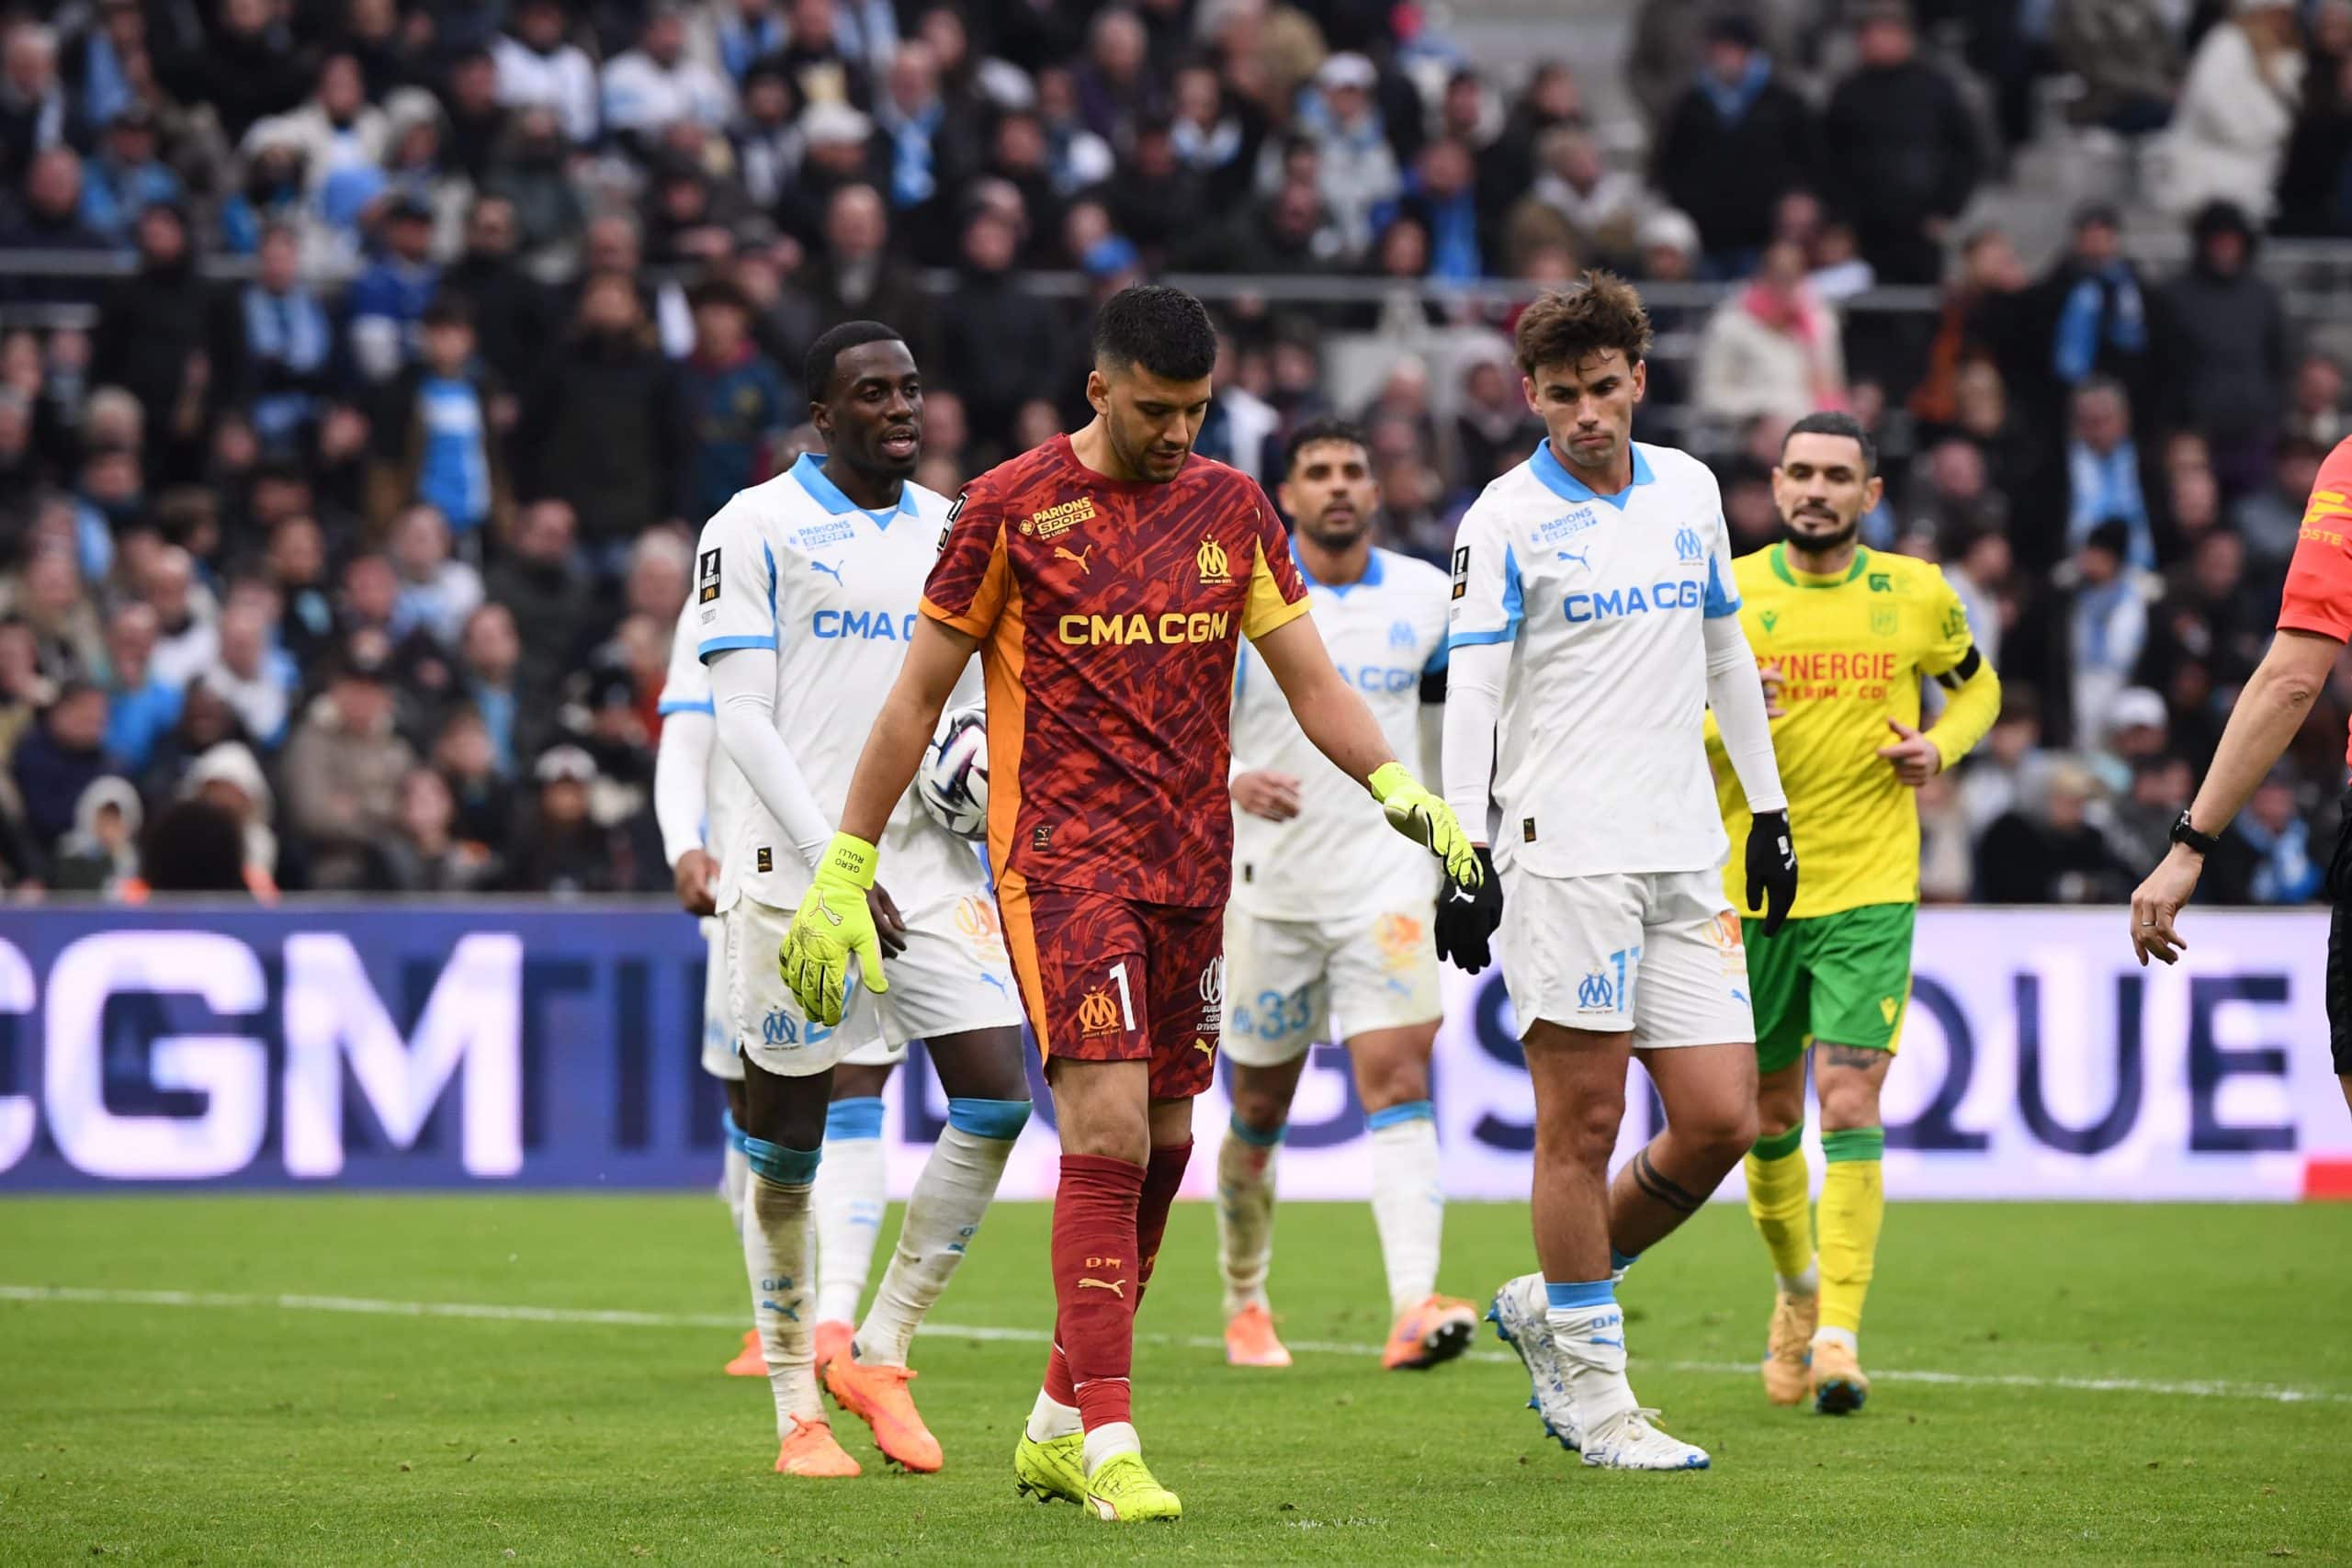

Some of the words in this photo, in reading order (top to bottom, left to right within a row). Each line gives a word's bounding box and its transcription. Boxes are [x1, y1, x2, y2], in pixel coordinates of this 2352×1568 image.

[1033, 497, 1091, 524] PARIONS
[1038, 508, 1095, 534] SPORT
[1540, 506, 1592, 532] PARIONS
[797, 519, 851, 536] PARIONS
[2299, 526, 2343, 547] OSTE
[1564, 586, 1648, 623] CMA
[813, 609, 896, 641] CMA
[1059, 613, 1153, 645] CMA
[1159, 610, 1228, 644] CGM
[1780, 685, 1838, 700] TERIM
[834, 858, 861, 874] GERO
[838, 848, 865, 864] RULLI
[1109, 962, 1136, 1032] 1
[1258, 986, 1313, 1041] 33
[0, 928, 524, 1180] GM
